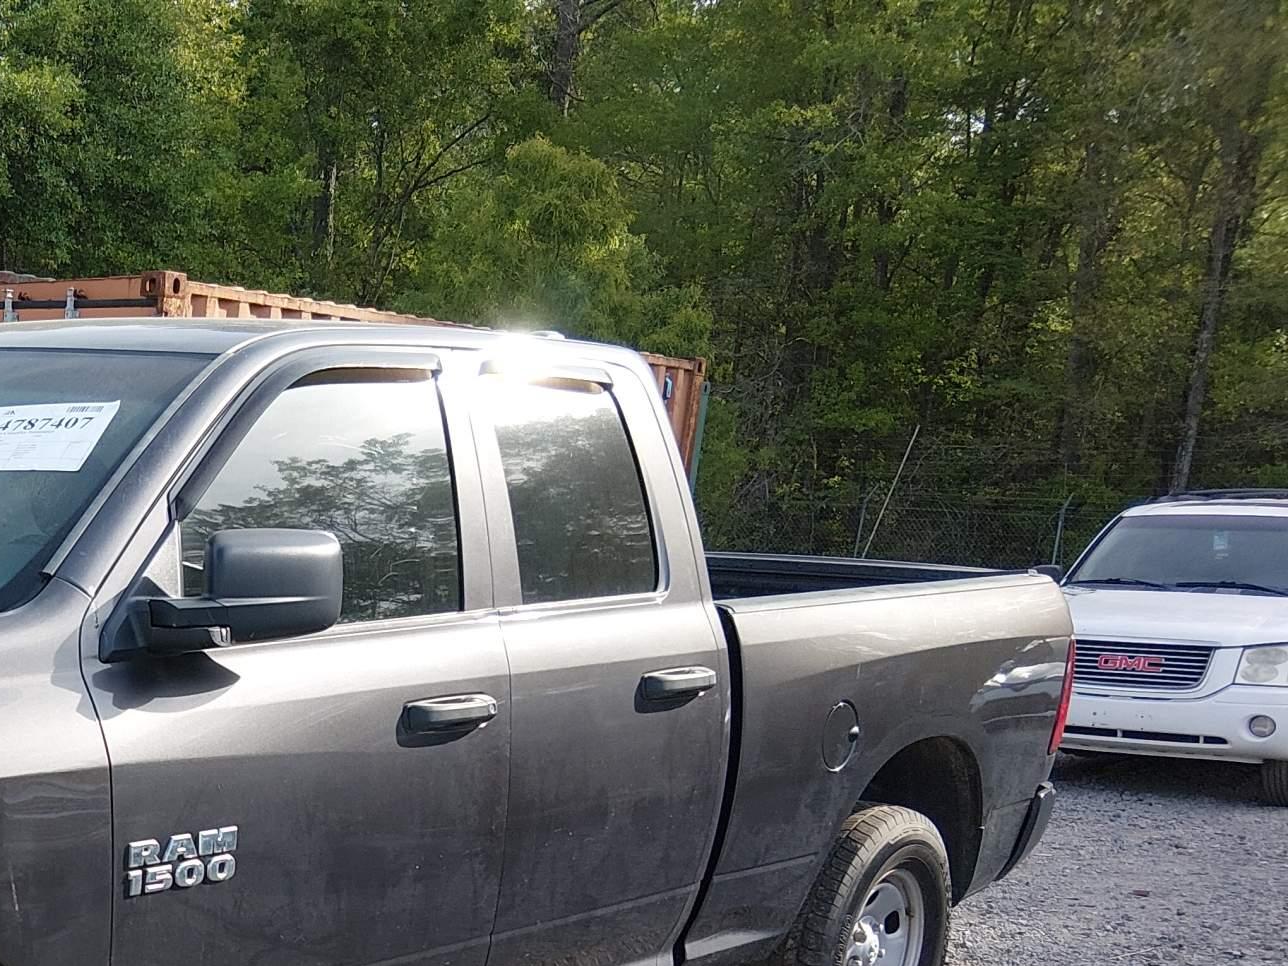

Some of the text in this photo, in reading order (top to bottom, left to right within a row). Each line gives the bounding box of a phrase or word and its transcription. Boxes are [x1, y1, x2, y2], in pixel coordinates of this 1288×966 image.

[1097, 654, 1164, 672] GMC
[127, 825, 239, 868] RAM
[127, 853, 236, 897] 1500
